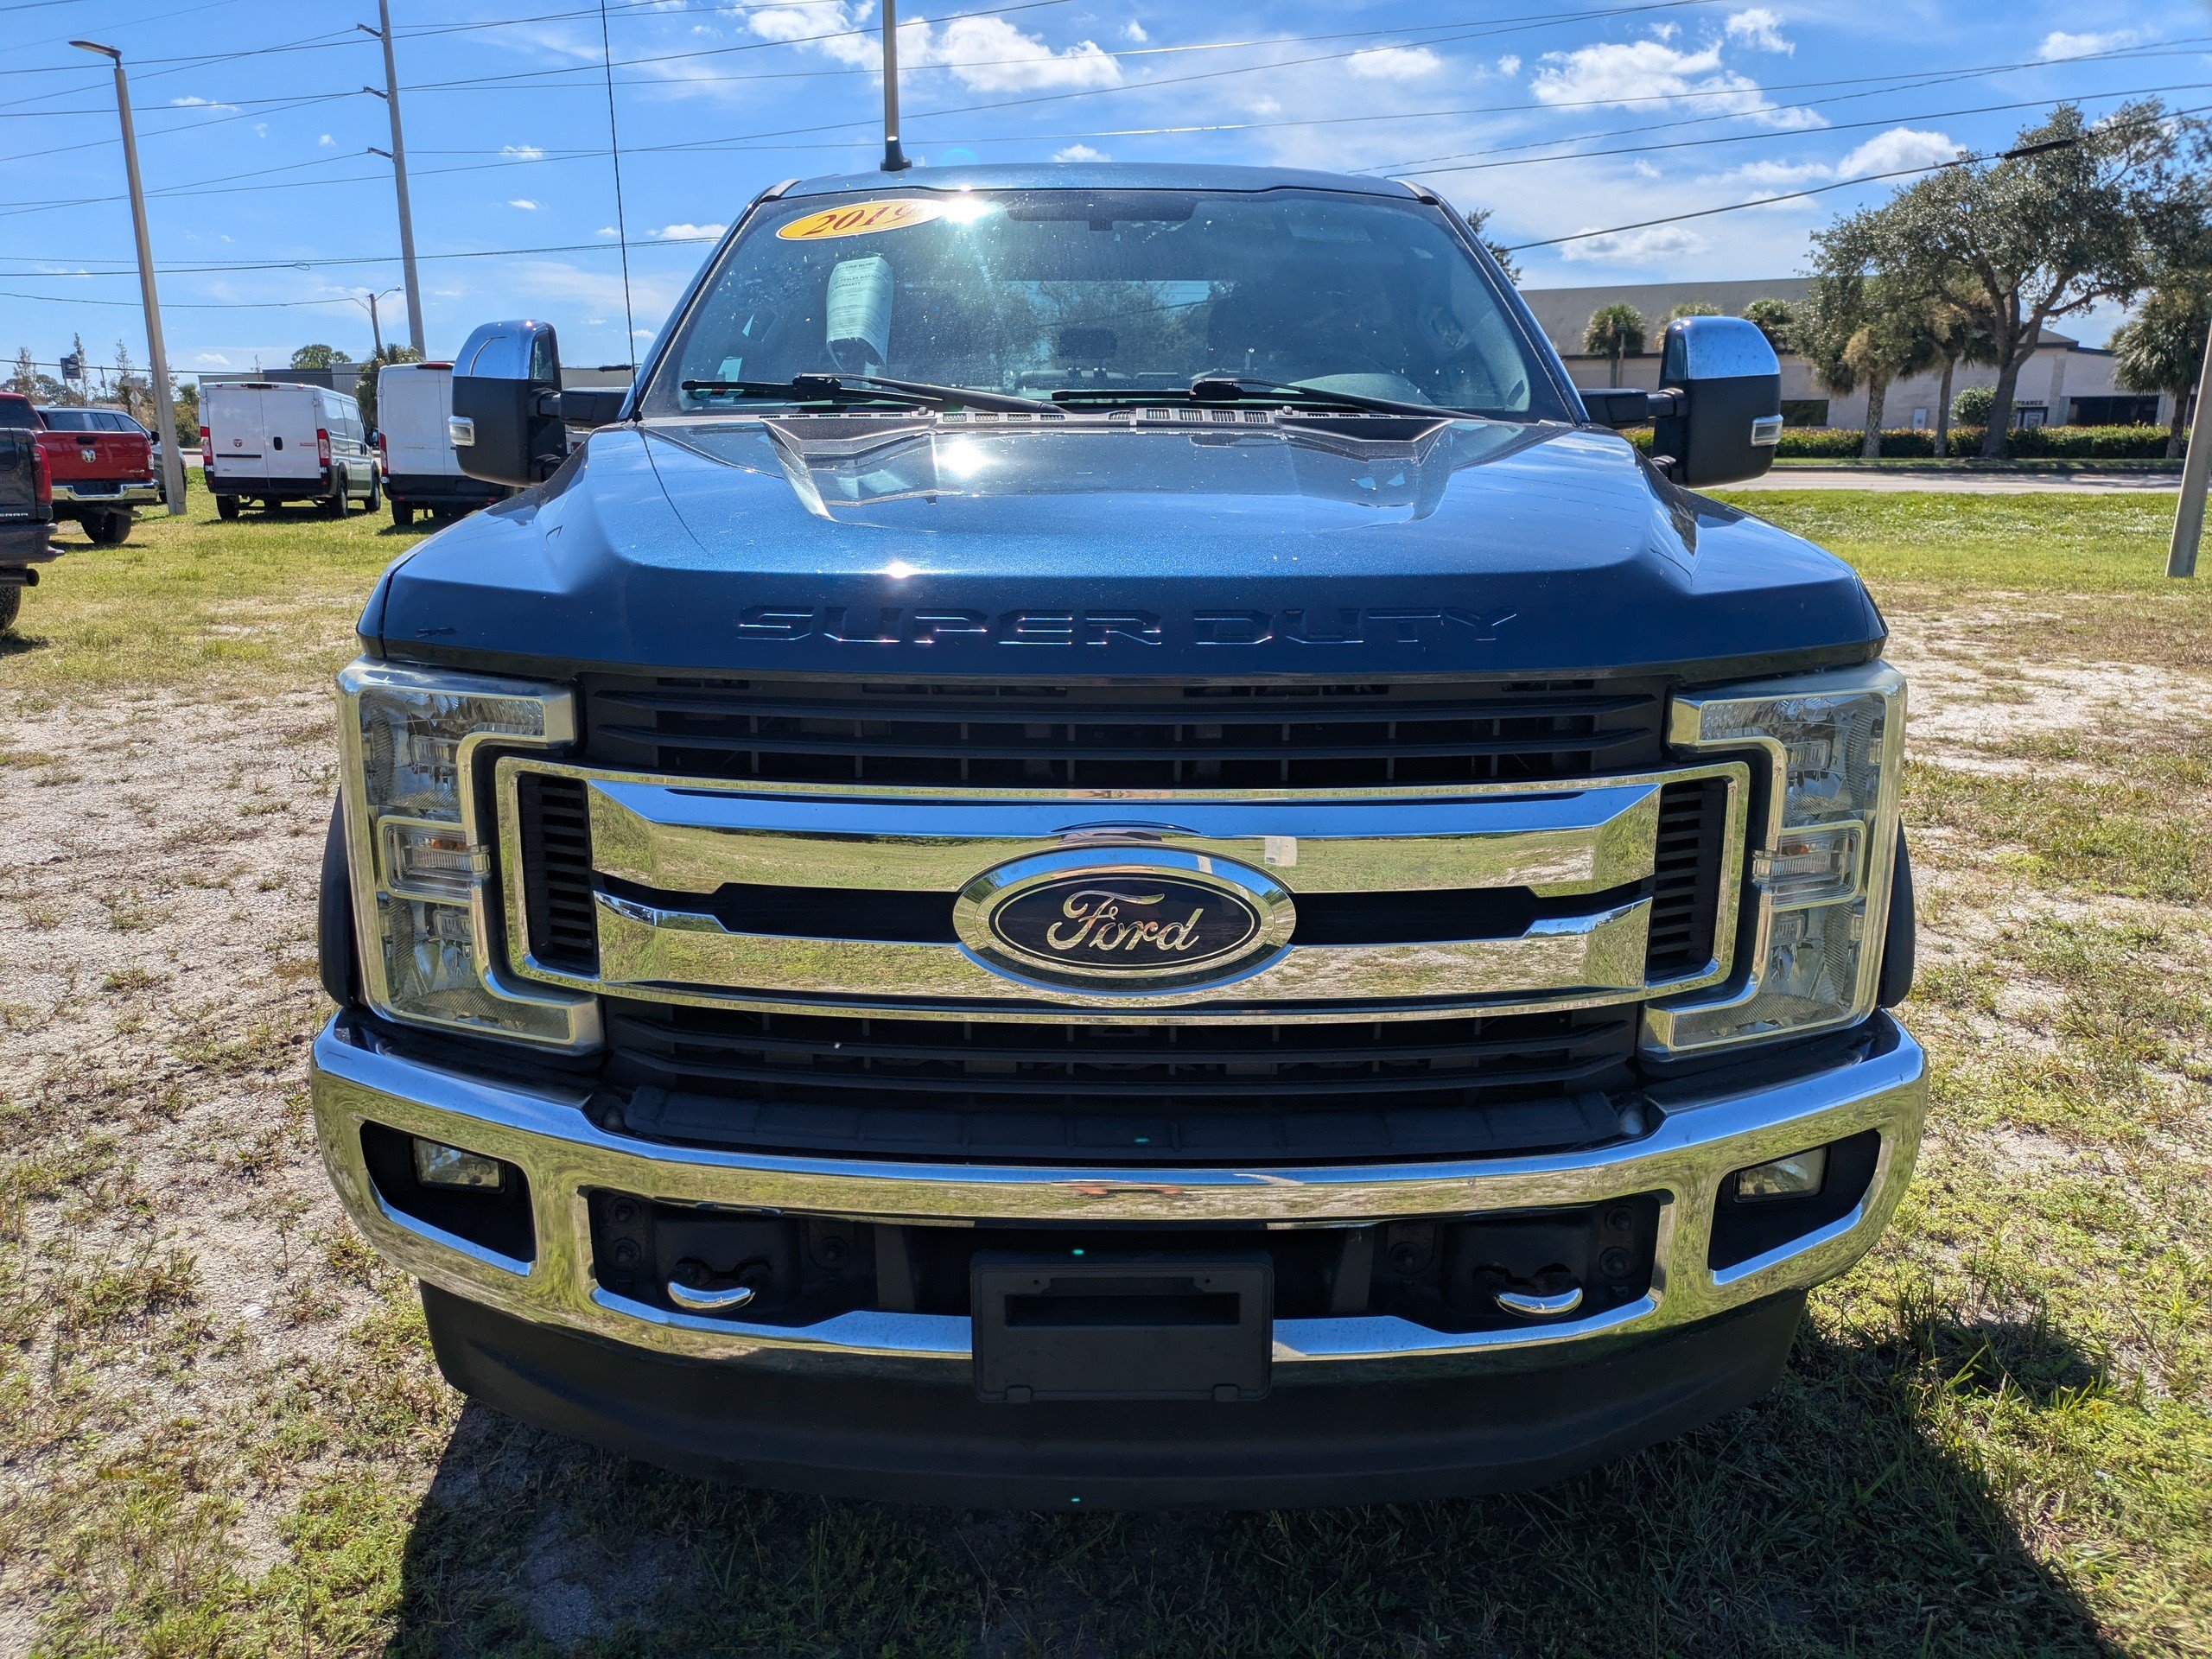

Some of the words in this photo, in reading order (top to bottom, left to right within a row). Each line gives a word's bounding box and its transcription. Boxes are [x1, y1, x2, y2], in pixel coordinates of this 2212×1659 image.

[800, 202, 920, 237] 2019
[736, 607, 1163, 645] SUPER
[1192, 607, 1518, 645] DUTY
[1046, 889, 1205, 951] Ford
